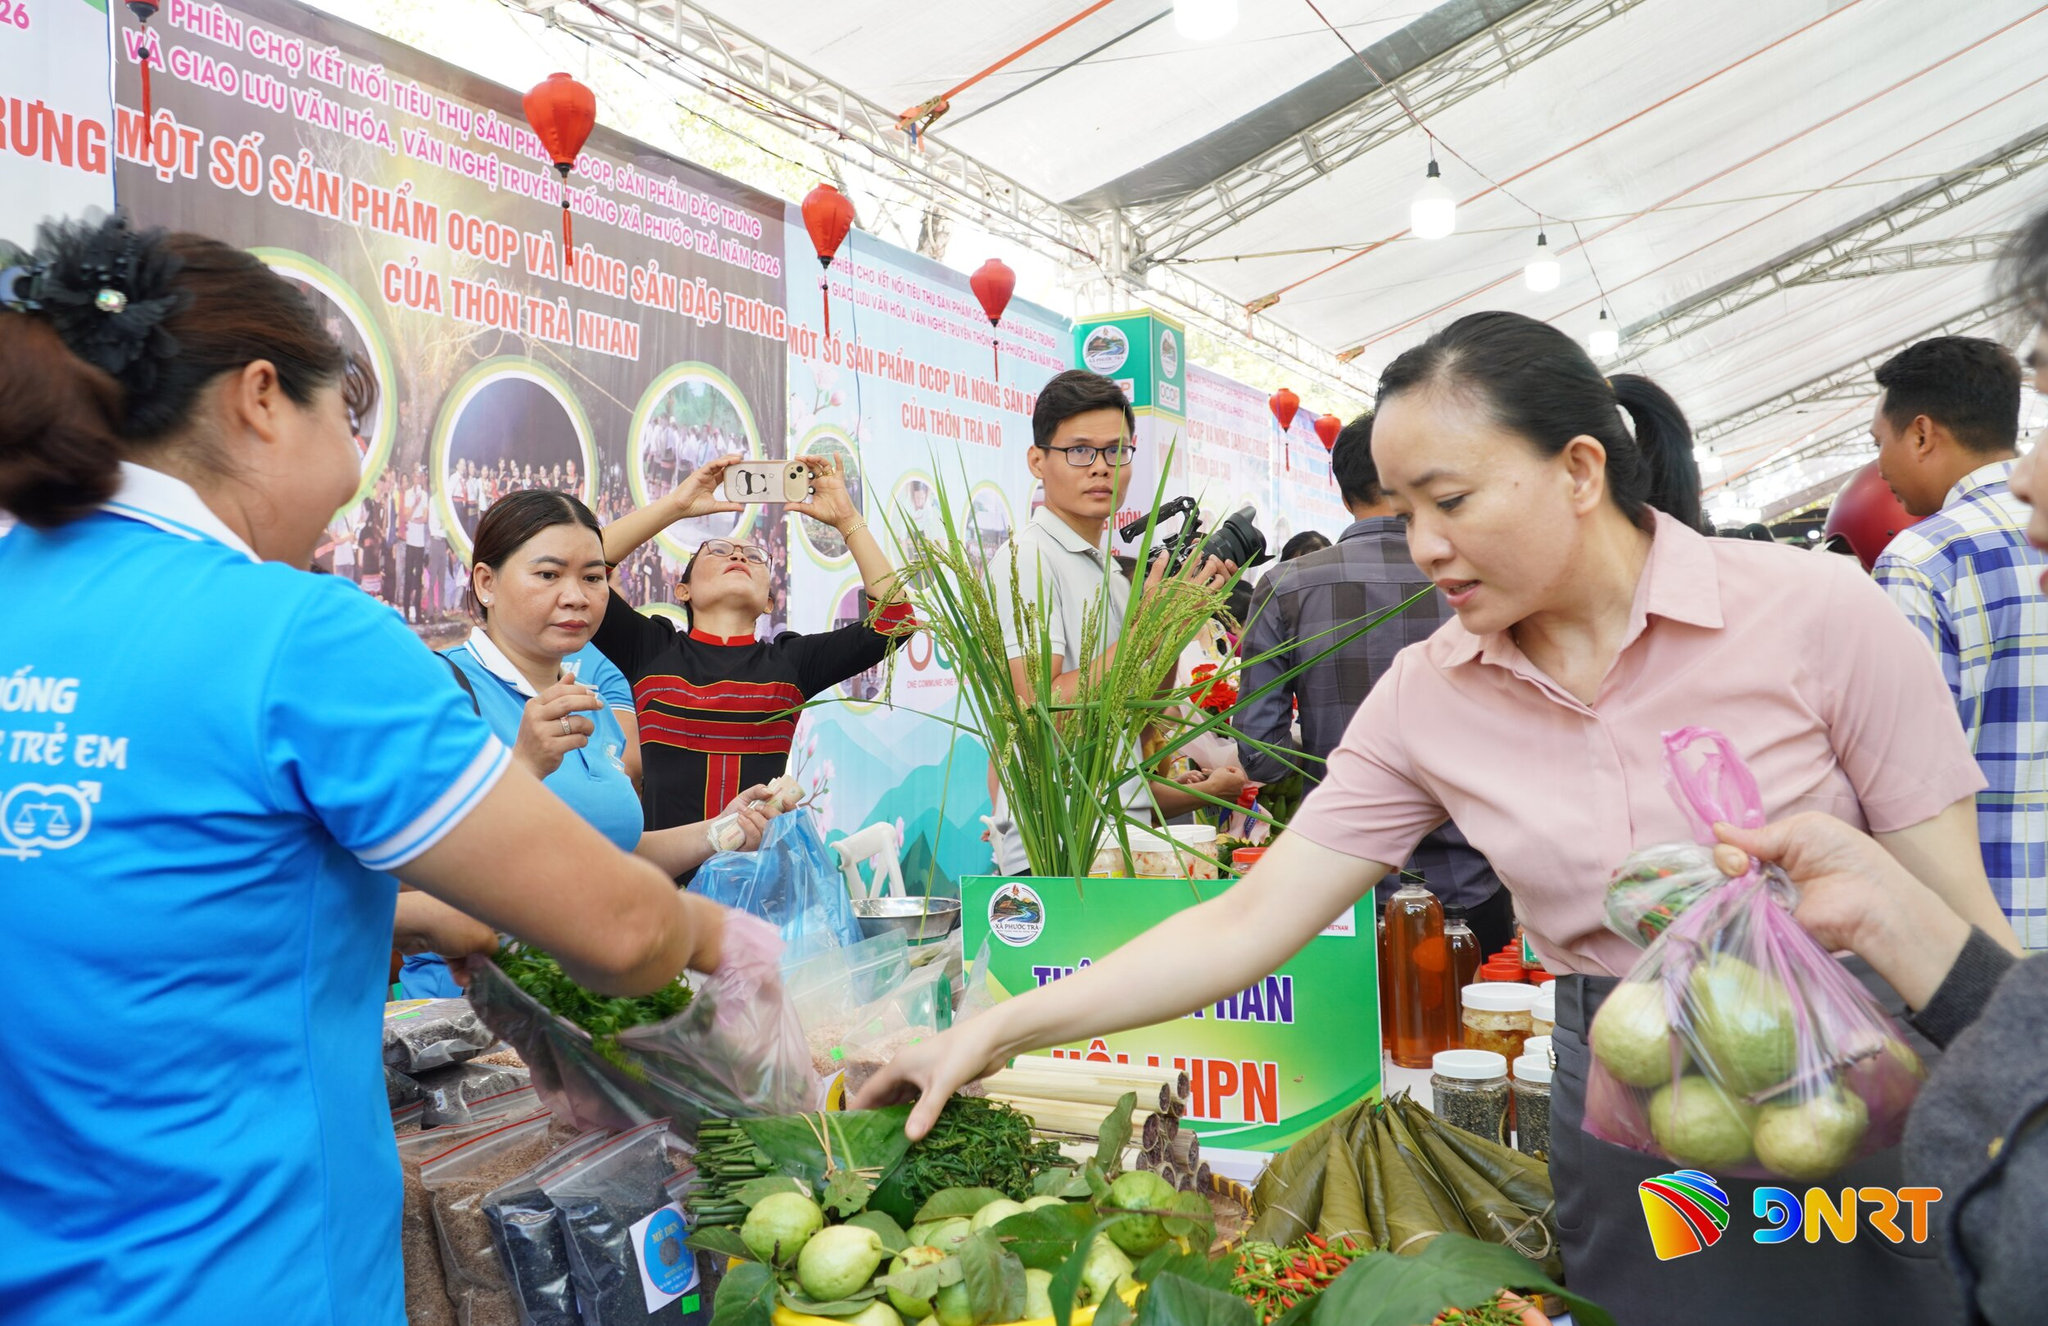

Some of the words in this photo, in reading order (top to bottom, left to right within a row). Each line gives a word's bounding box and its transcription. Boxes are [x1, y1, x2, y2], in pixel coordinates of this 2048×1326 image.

[124, 29, 165, 69] VÀ
[171, 48, 237, 93] GIAO
[243, 72, 286, 110] LƯU
[292, 89, 340, 125] VĂN
[345, 103, 397, 154] HÓA,
[403, 130, 443, 166] VĂN
[449, 147, 497, 192] NGHỆ
[502, 165, 560, 205] TRUYỀN
[564, 186, 617, 223] THỐNG
[620, 204, 641, 232] XÃ
[644, 213, 693, 249] PHƯỚC
[695, 231, 718, 256] TRÀ
[722, 239, 750, 268] NĂM
[752, 252, 780, 277] 2026
[169, 0, 242, 49] PHIÊN
[248, 29, 303, 76] CHỢ
[308, 47, 345, 87] KẾT
[351, 63, 388, 101] NỐI
[394, 81, 431, 118] TIÊU
[437, 99, 471, 140] THỤ
[476, 110, 510, 147] SẢN
[616, 165, 645, 198] SẢN
[649, 177, 688, 214] PHẨM
[690, 194, 719, 226] ĐẶC
[722, 208, 762, 239] TRƯNG
[116, 107, 201, 178] MỘT
[212, 133, 262, 194] SỐ
[272, 150, 340, 217] SẢN
[352, 182, 438, 245] PHẨM
[448, 212, 518, 267] OCOP
[525, 233, 556, 279] VÀ
[564, 245, 625, 297] NÔNG
[632, 261, 676, 309] SẢN
[680, 277, 721, 325] ĐẶC
[724, 295, 785, 340] TRƯNG
[384, 256, 441, 312] CỦA
[452, 279, 519, 327] THÔN
[526, 298, 572, 345] TRÀ
[578, 313, 639, 358] NHAN
[832, 281, 853, 301] GIAO
[787, 322, 817, 363] MỘT
[822, 329, 842, 366] SỐ
[846, 336, 874, 375] SẢN
[878, 347, 915, 386] PHẨM
[919, 363, 950, 396] OCOP
[953, 369, 968, 400] VÀ
[971, 375, 1001, 408] NÔNG
[1004, 381, 1024, 415] SẢN
[901, 396, 927, 433] CỦA
[930, 408, 960, 440] THÔN
[964, 415, 985, 445] TRÀ
[0, 664, 80, 714] ỐNG
[9, 721, 68, 766] TRẺ
[74, 733, 130, 770] EM
[1148, 1056, 1279, 1124] HPN
